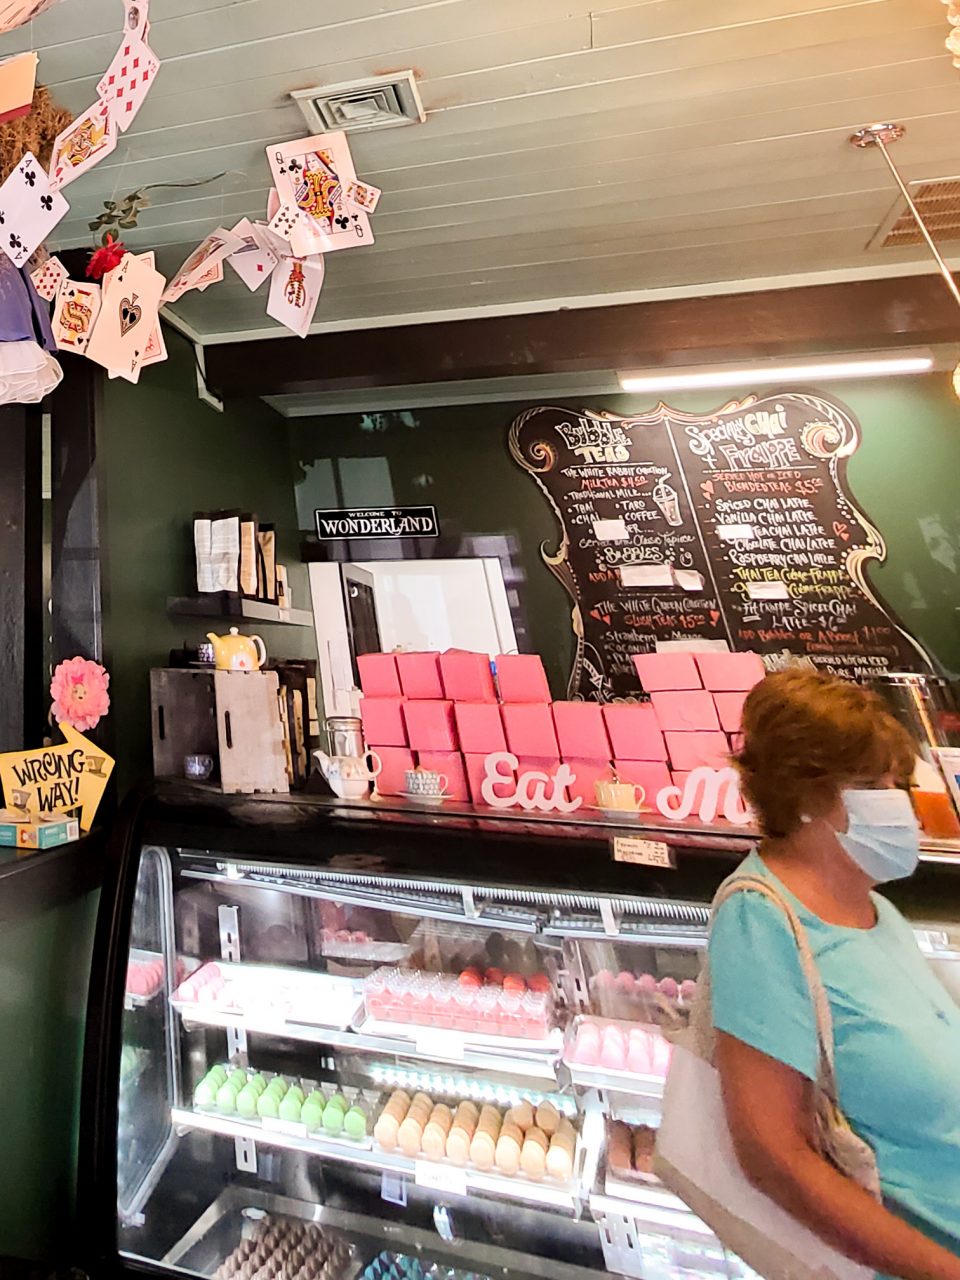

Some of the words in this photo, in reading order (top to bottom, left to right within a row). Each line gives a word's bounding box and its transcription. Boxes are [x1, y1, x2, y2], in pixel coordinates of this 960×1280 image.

[275, 151, 284, 164] Q
[354, 224, 364, 238] Q
[620, 500, 646, 511] TARO
[624, 510, 662, 521] COFFEE
[320, 515, 434, 536] WONDERLAND
[594, 600, 619, 616] THE
[11, 749, 86, 787] WRONG
[36, 776, 81, 812] WAY!
[480, 750, 584, 813] Eat
[655, 766, 753, 824] M
